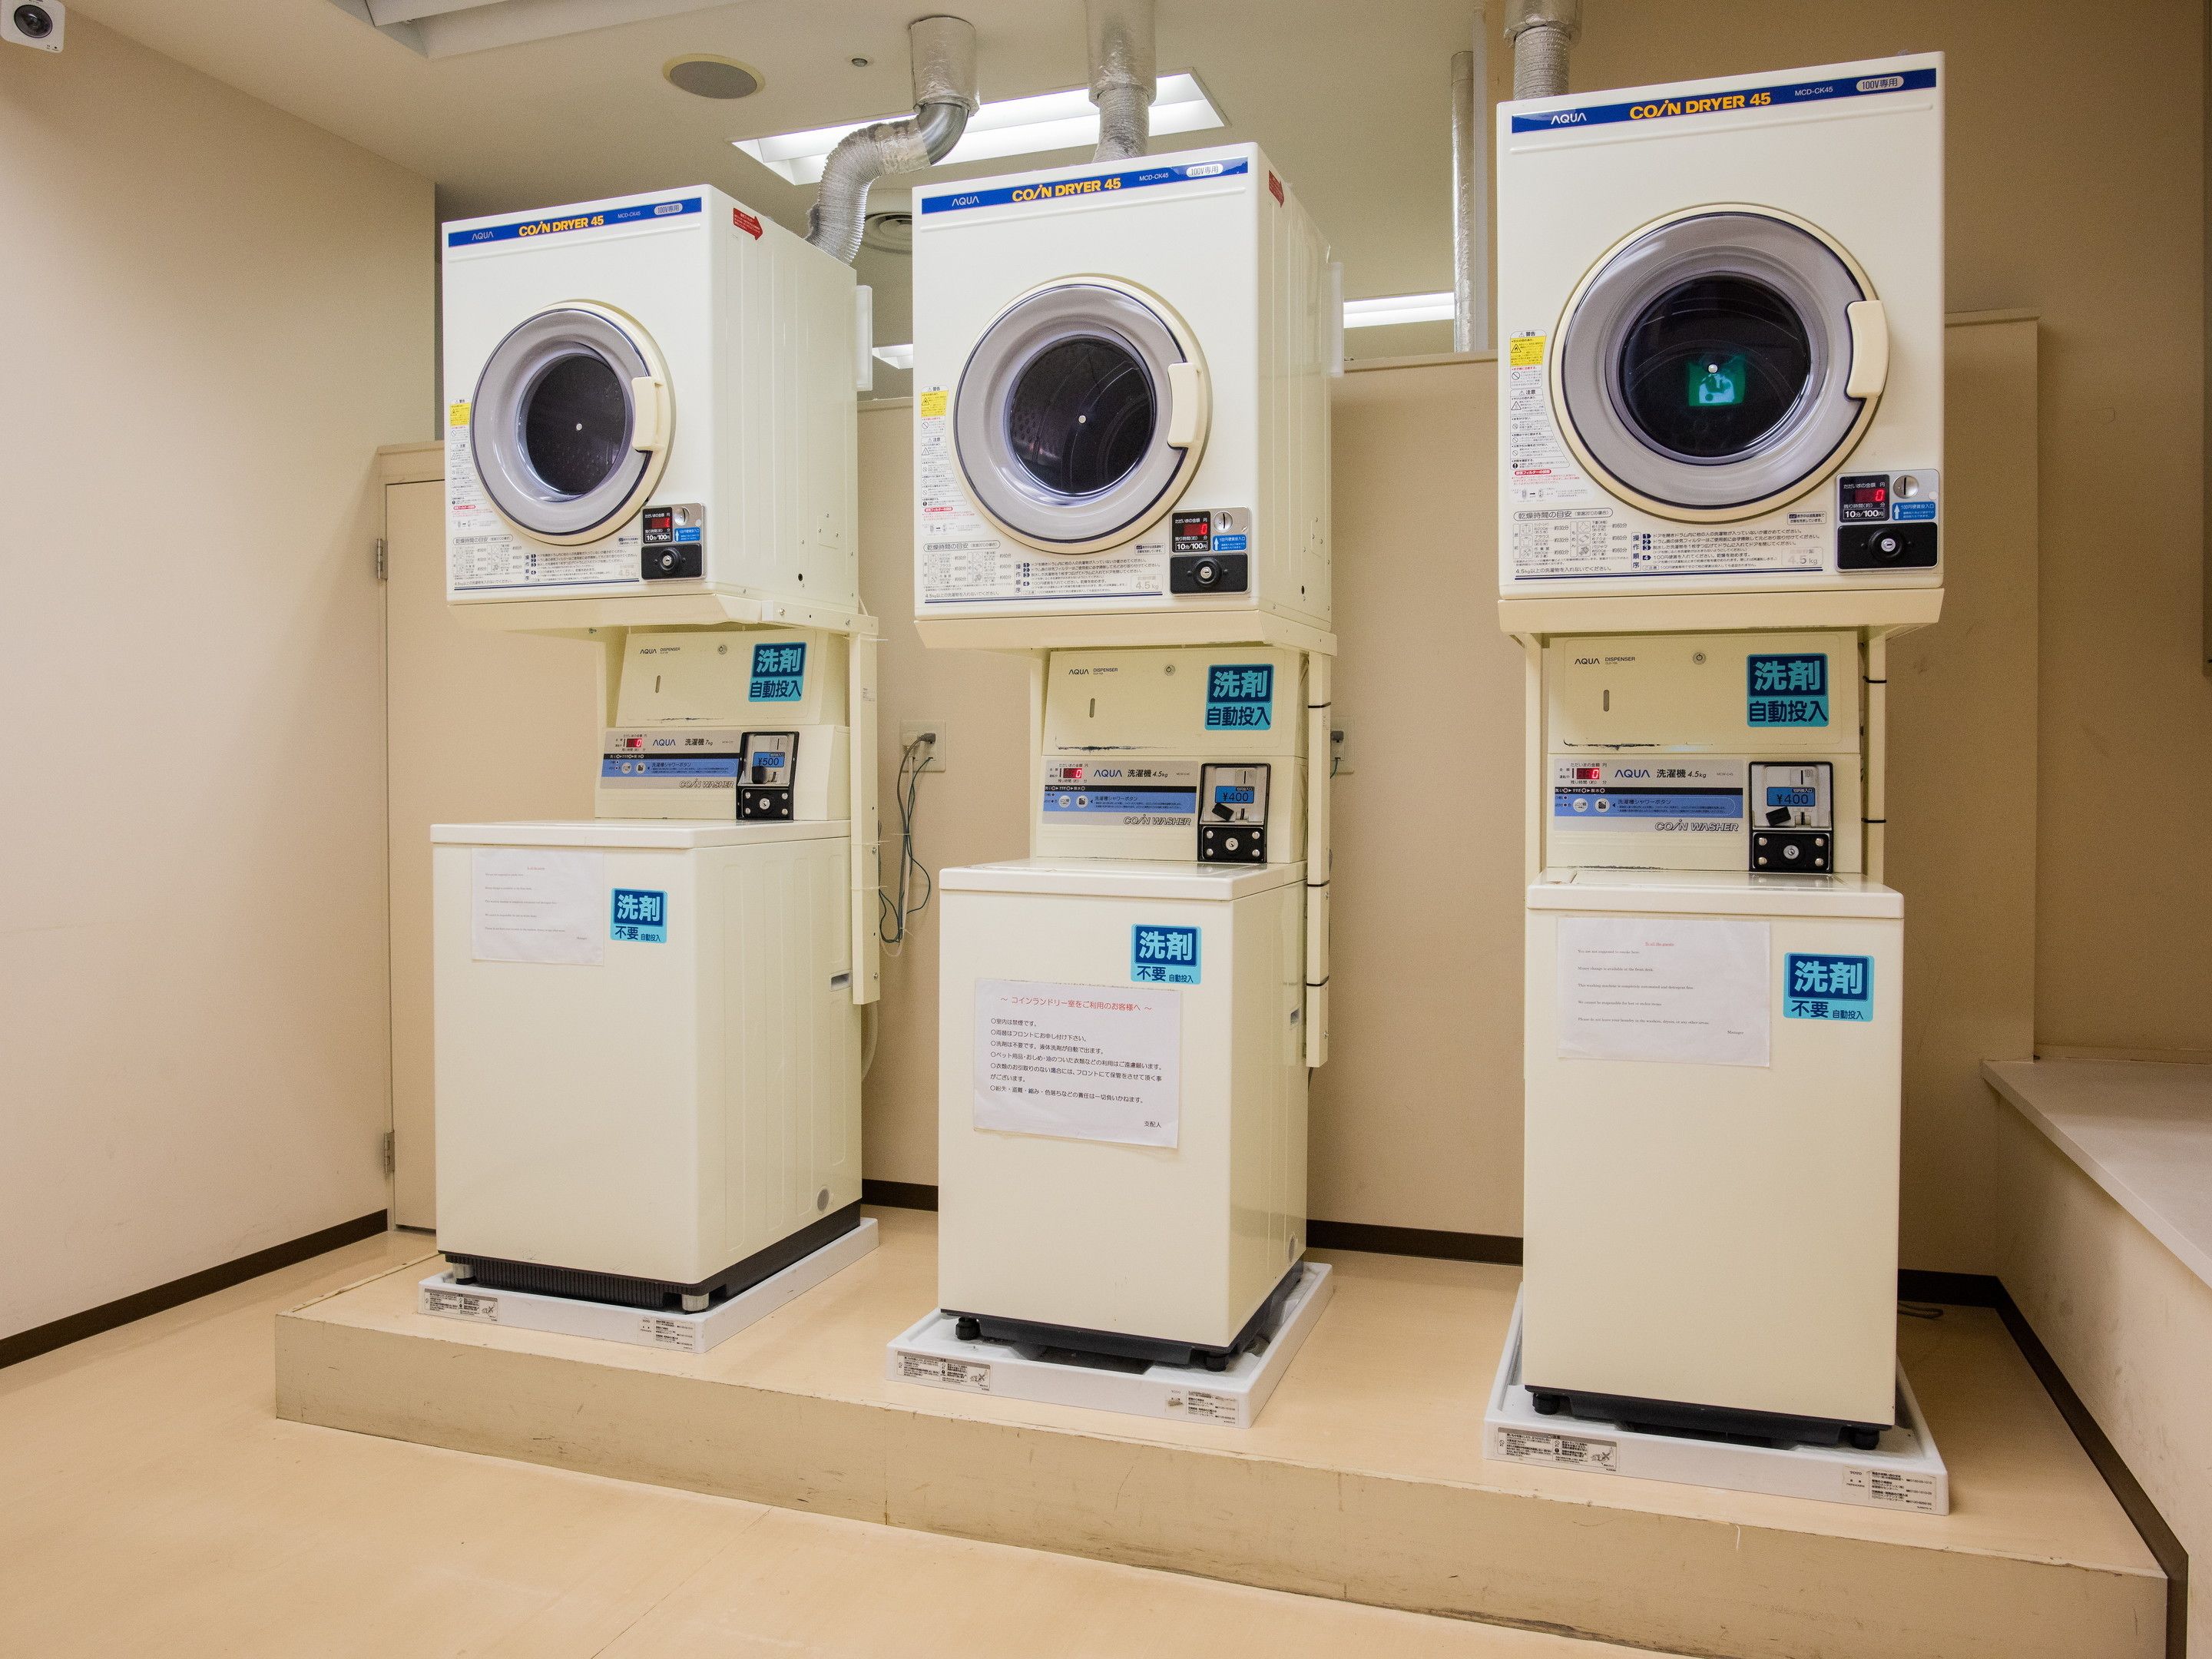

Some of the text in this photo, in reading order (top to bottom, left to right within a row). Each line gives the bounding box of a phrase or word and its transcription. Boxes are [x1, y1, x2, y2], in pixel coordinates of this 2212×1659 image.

[1551, 113, 1587, 124] AQUA
[1685, 95, 1745, 113] DRYER
[1750, 93, 1770, 105] 45
[1795, 87, 1833, 96] MCD-CK45
[952, 196, 979, 207] AQUA
[1055, 180, 1101, 197] DRYER
[1104, 178, 1121, 189] 45
[472, 231, 493, 240] AQUA
[552, 217, 588, 232] DRYER
[591, 214, 604, 227] 45
[1876, 488, 1885, 502] 0
[1518, 511, 1572, 519] 乾燥時間の目安
[1200, 524, 1207, 534] 0
[756, 647, 801, 673] 洗剤
[1213, 671, 1267, 698] 洗剤
[1754, 660, 1821, 692] 洗剤
[750, 680, 802, 698] 自動投入
[1207, 706, 1270, 727] 自動投入
[1749, 700, 1828, 723] 自動投入
[758, 757, 780, 767] ¥500
[1075, 769, 1082, 778] 0
[1094, 769, 1122, 777] AQUA
[1127, 769, 1152, 778] 洗濯機
[1591, 769, 1599, 779] 0
[1614, 769, 1651, 778] AQUA
[1657, 769, 1686, 778] 洗濯機
[1687, 770, 1707, 779] 4.5kg
[1222, 792, 1249, 802] ¥400
[1776, 794, 1809, 804] ¥400
[1152, 816, 1192, 826] WASHER
[1691, 823, 1739, 832] WASHER
[618, 894, 661, 922] 洗剤
[614, 926, 661, 942] 不要 自動投入
[1139, 931, 1193, 961] 洗剤
[1137, 965, 1194, 983] 不要 自動投入
[1794, 960, 1863, 995] 洗剤
[1791, 1001, 1864, 1020] 不要 自動投入
